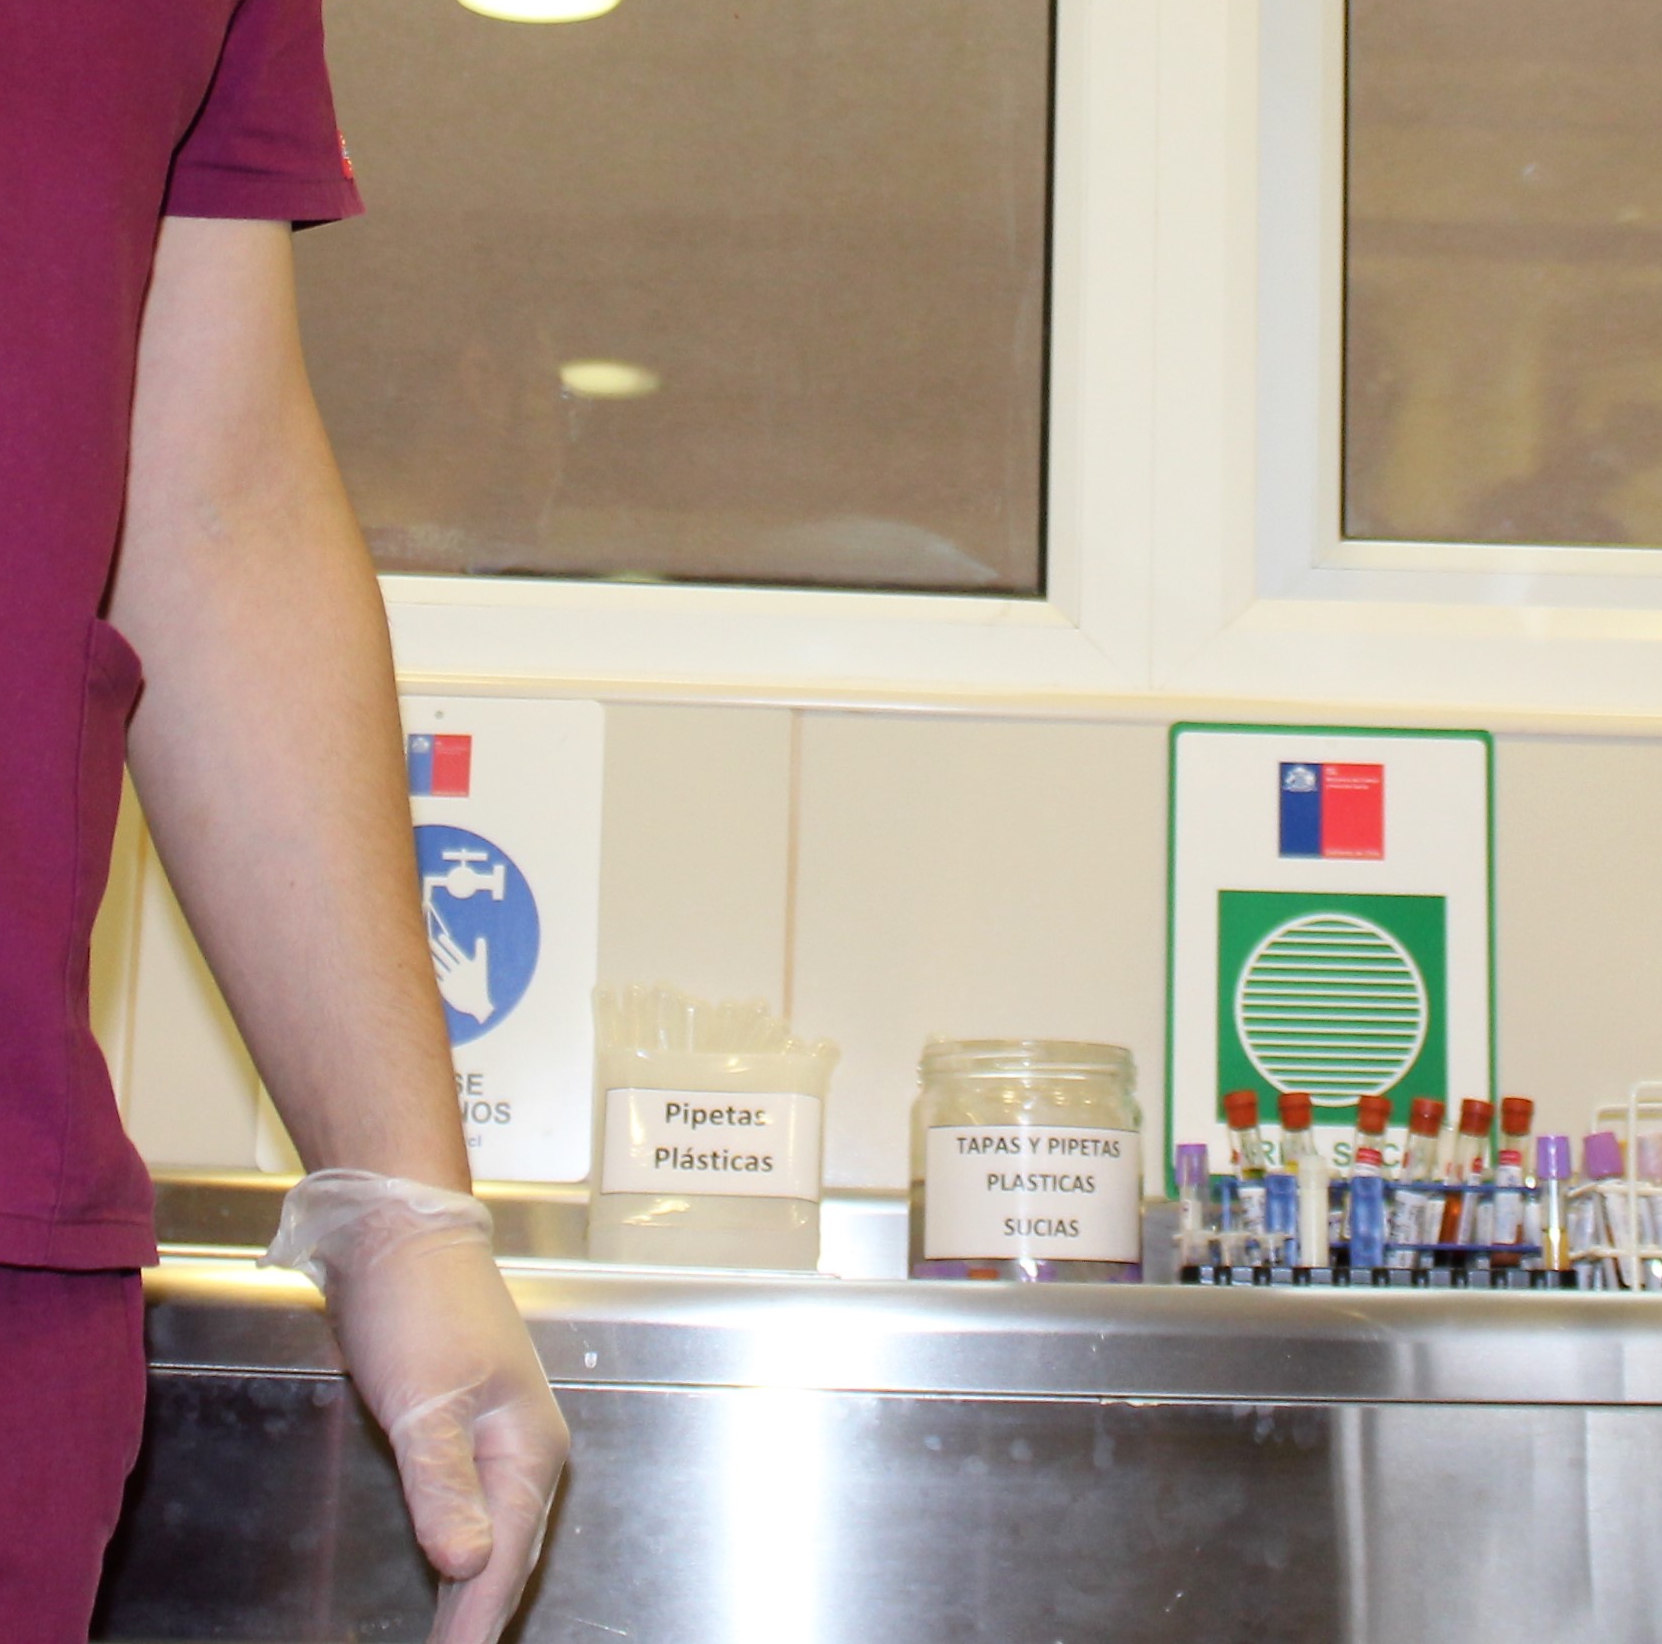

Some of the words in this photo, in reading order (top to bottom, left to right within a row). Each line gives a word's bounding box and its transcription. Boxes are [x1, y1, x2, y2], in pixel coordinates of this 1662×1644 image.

[665, 1103, 766, 1129] Pipetas
[956, 1137, 1021, 1155] TAPAS
[1028, 1137, 1041, 1154] Y
[1048, 1138, 1121, 1157] PIPETAS
[654, 1147, 773, 1172] Plásticas
[987, 1173, 1096, 1193] PLASTICAS
[1004, 1218, 1080, 1238] SUCIAS
